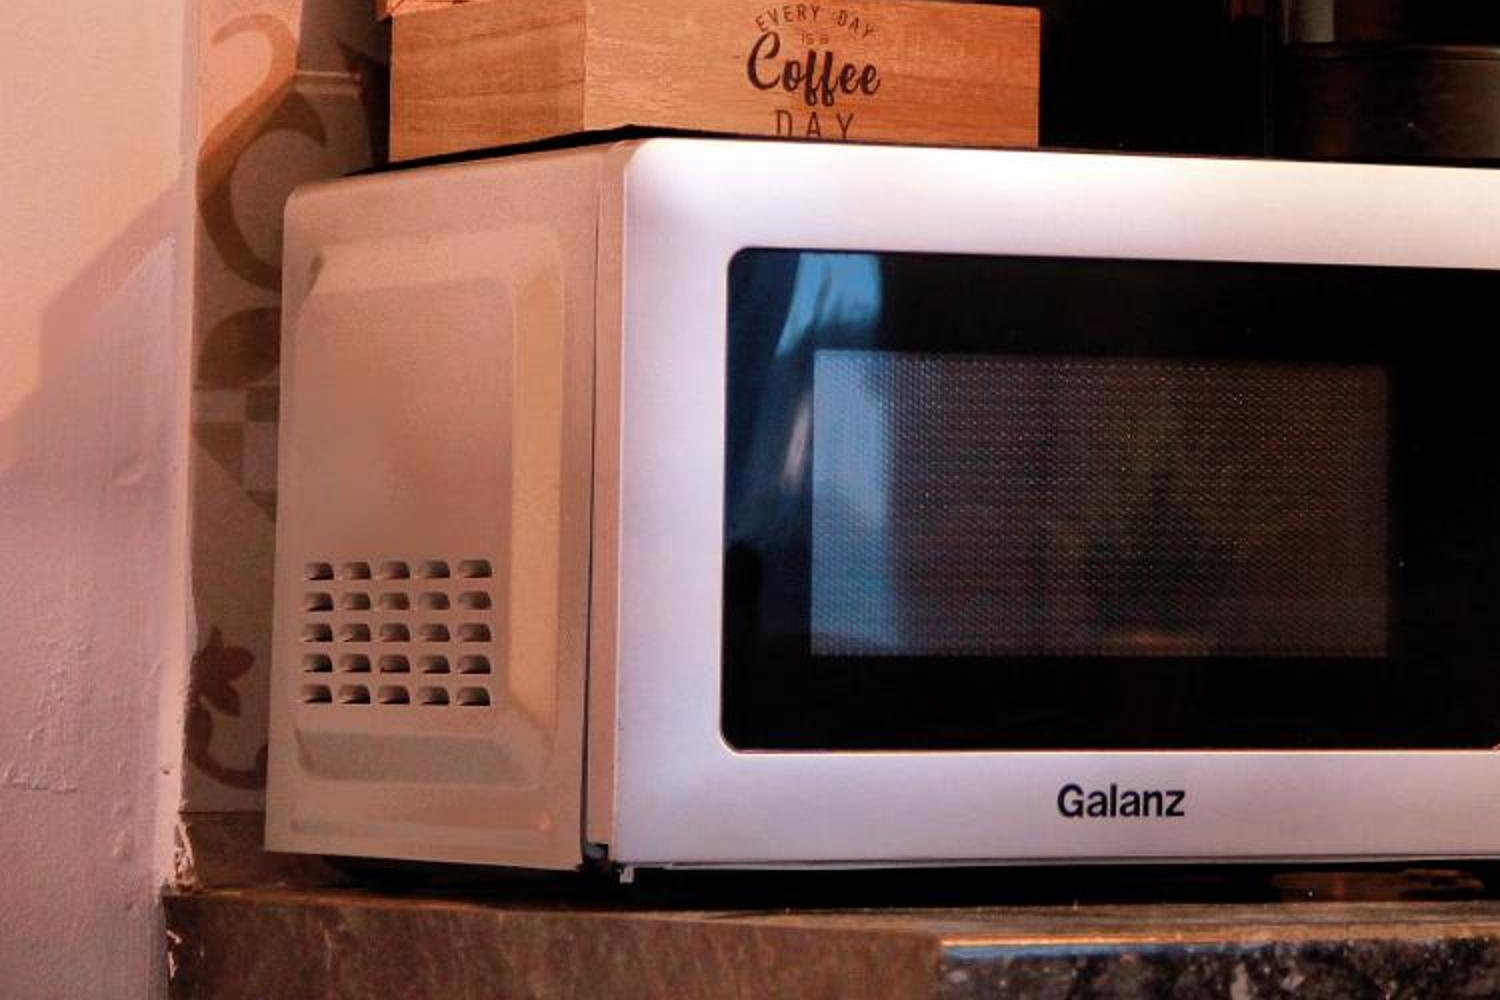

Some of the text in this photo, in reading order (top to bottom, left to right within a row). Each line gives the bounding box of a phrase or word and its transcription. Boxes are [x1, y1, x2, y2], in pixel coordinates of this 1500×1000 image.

[755, 4, 877, 39] EVERY DAY
[747, 31, 881, 107] Coffee
[774, 109, 854, 138] DAY
[1057, 783, 1186, 817] Galanz
